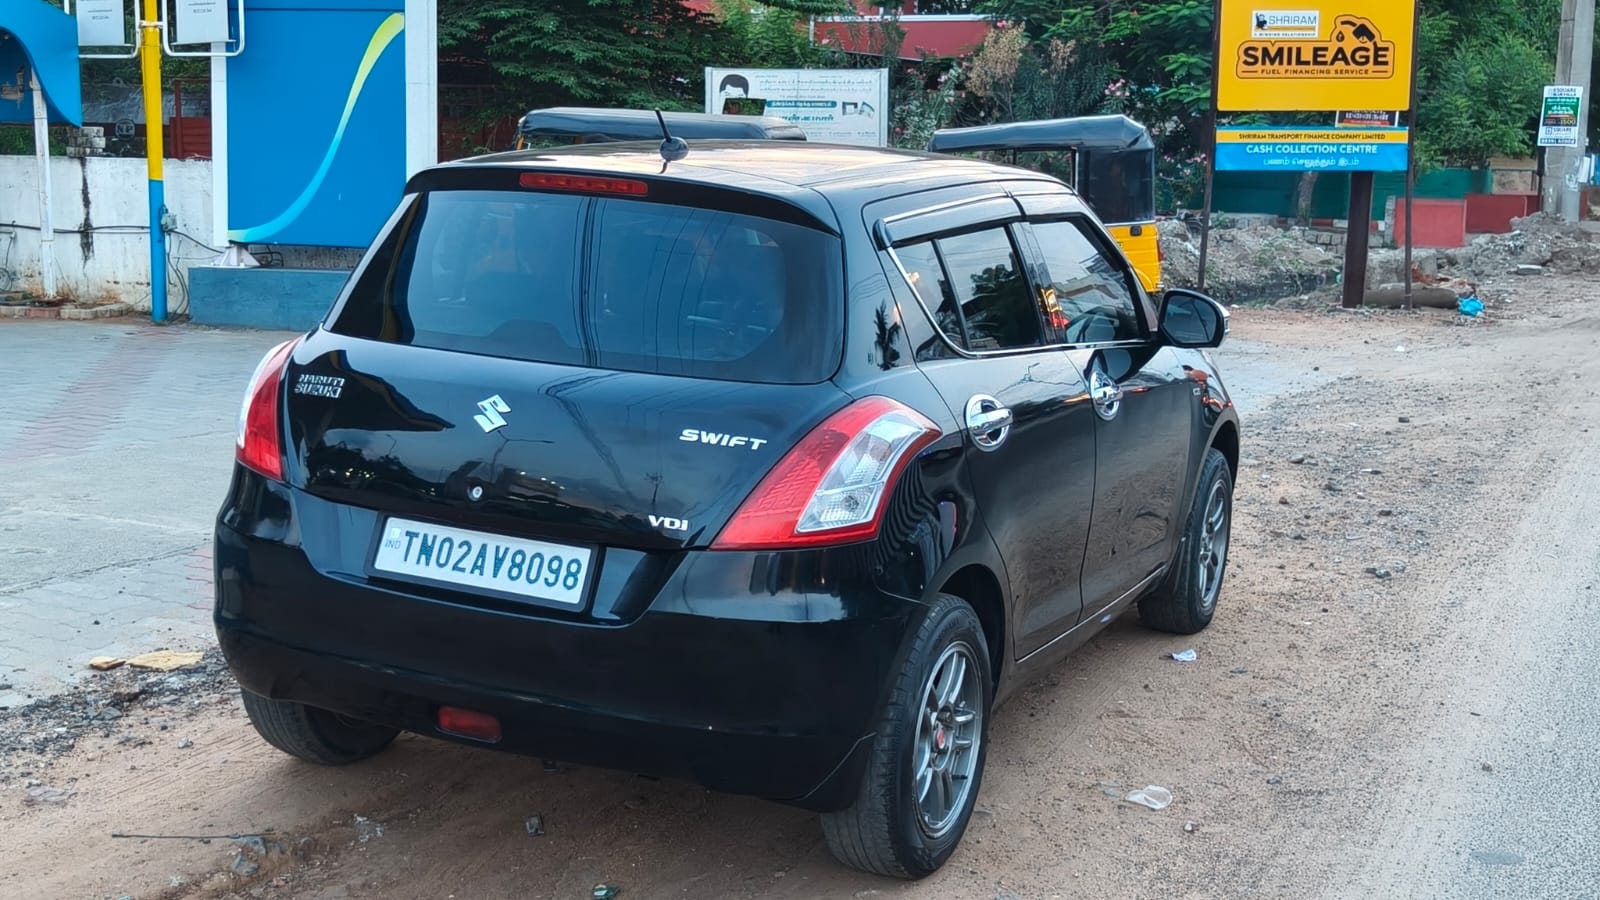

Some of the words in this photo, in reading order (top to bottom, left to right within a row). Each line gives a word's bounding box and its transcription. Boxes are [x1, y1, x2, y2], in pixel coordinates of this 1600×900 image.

[1269, 15, 1317, 25] SHRIRAM
[1242, 46, 1390, 67] SMILEAGE
[1246, 145, 1273, 154] CASH
[1275, 145, 1337, 154] COLLECTION
[1339, 145, 1377, 154] CENTRE
[1264, 156, 1290, 166] பணம்
[1338, 157, 1359, 167] இடம்
[298, 374, 345, 387] MARUTI
[294, 382, 342, 398] SUZUKI
[679, 428, 768, 450] SWIFT
[384, 539, 400, 548] IND
[402, 530, 583, 591] TN02AV8098
